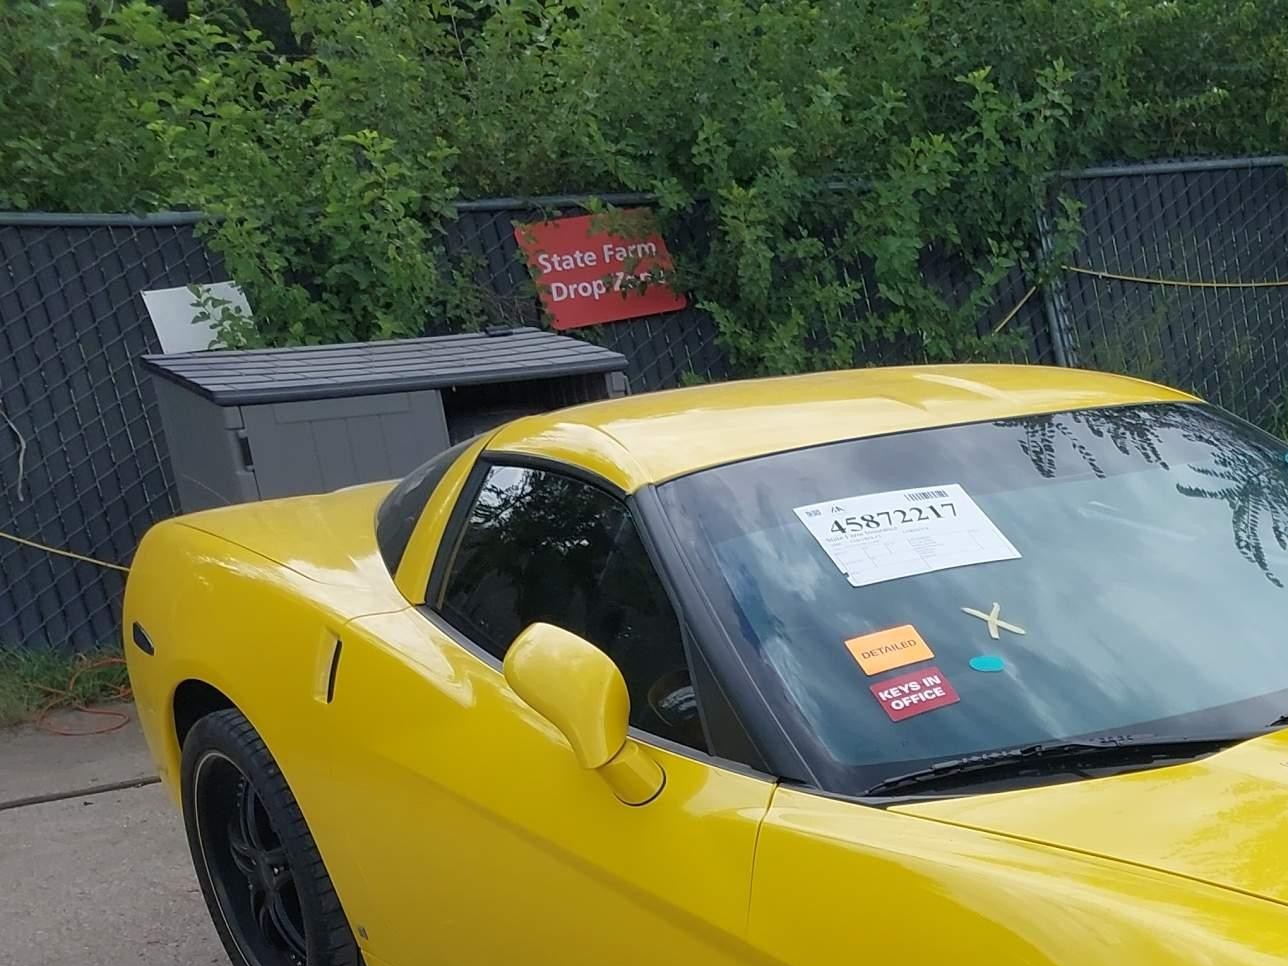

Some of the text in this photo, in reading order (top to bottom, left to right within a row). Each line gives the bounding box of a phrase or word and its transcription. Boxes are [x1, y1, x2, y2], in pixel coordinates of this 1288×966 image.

[538, 241, 656, 274] State Farm
[551, 280, 606, 302] Drop
[830, 502, 958, 535] 45872217
[861, 638, 917, 660] DETAILED
[879, 674, 942, 701] KEYS IN
[890, 687, 946, 711] OFFICE
